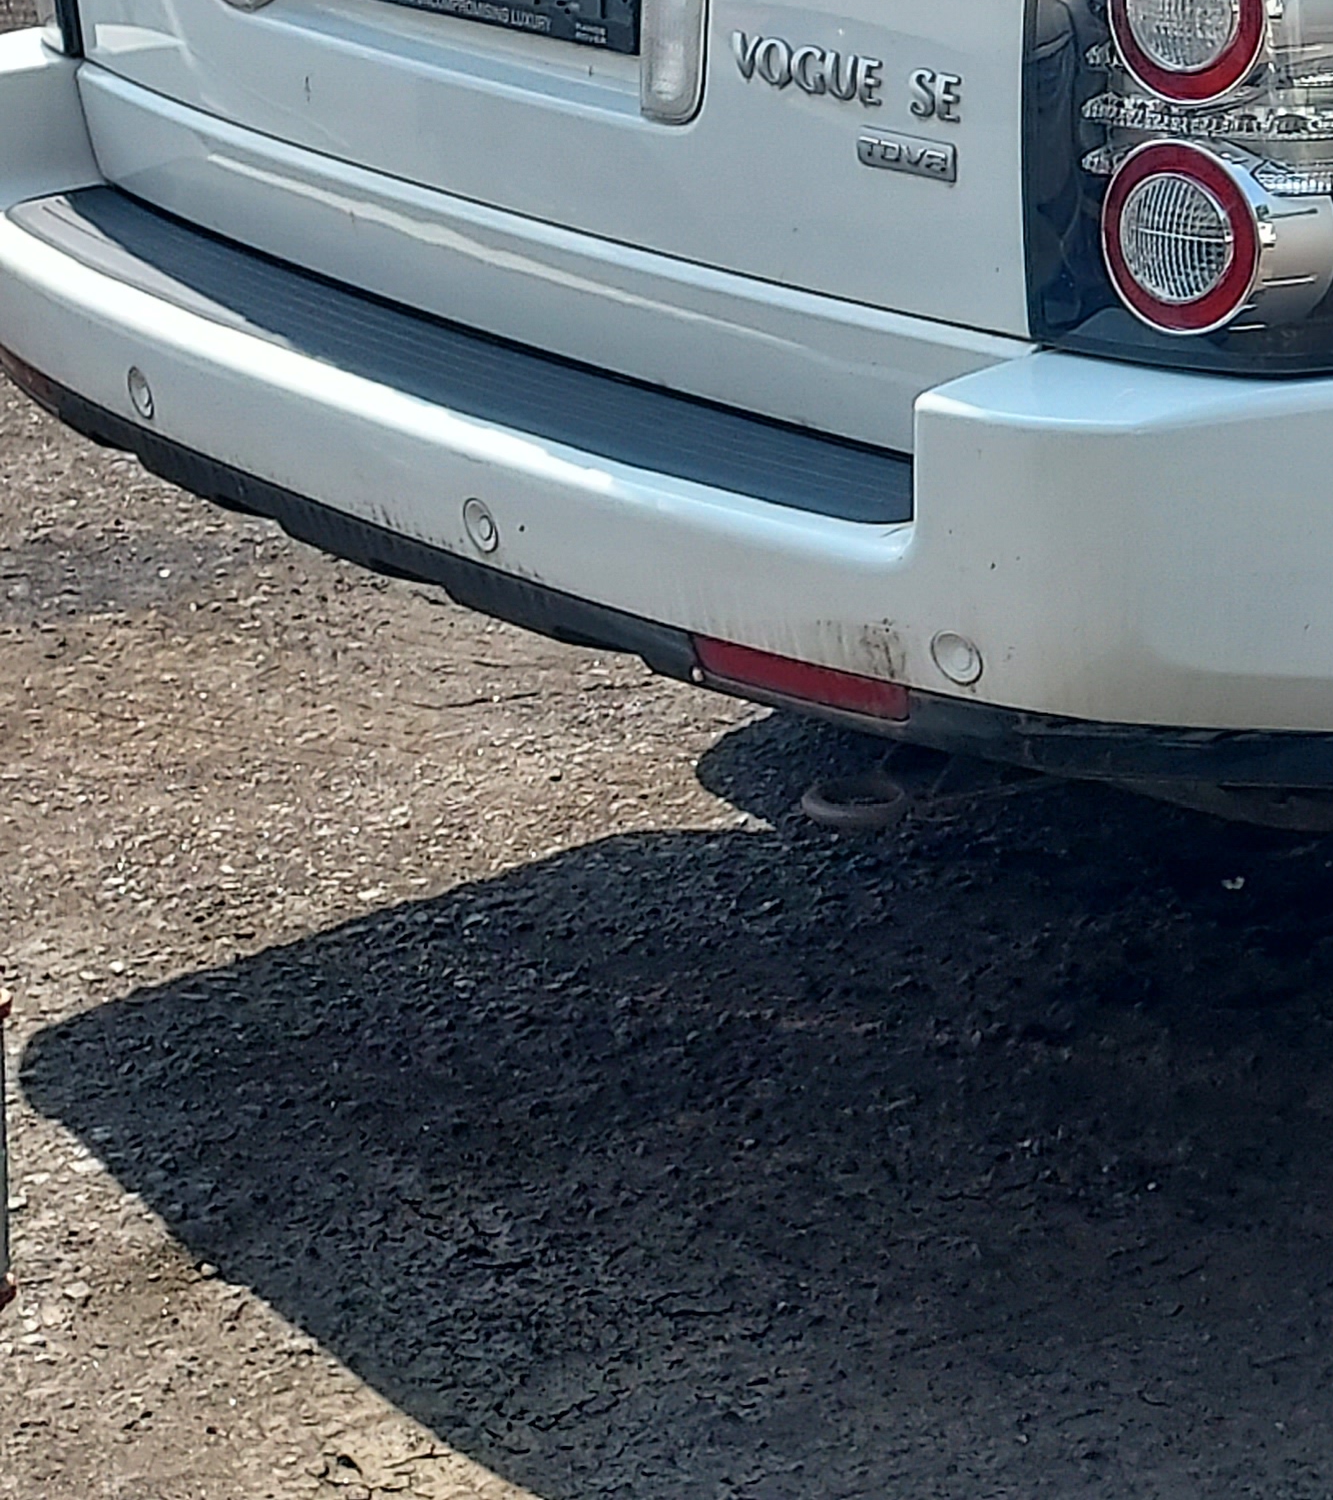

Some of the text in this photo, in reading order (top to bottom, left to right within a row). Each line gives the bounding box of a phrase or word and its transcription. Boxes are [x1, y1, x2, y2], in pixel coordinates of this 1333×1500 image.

[510, 8, 551, 33] LUXURY
[732, 30, 961, 124] VOGUE SE
[858, 135, 949, 173] TDV8
